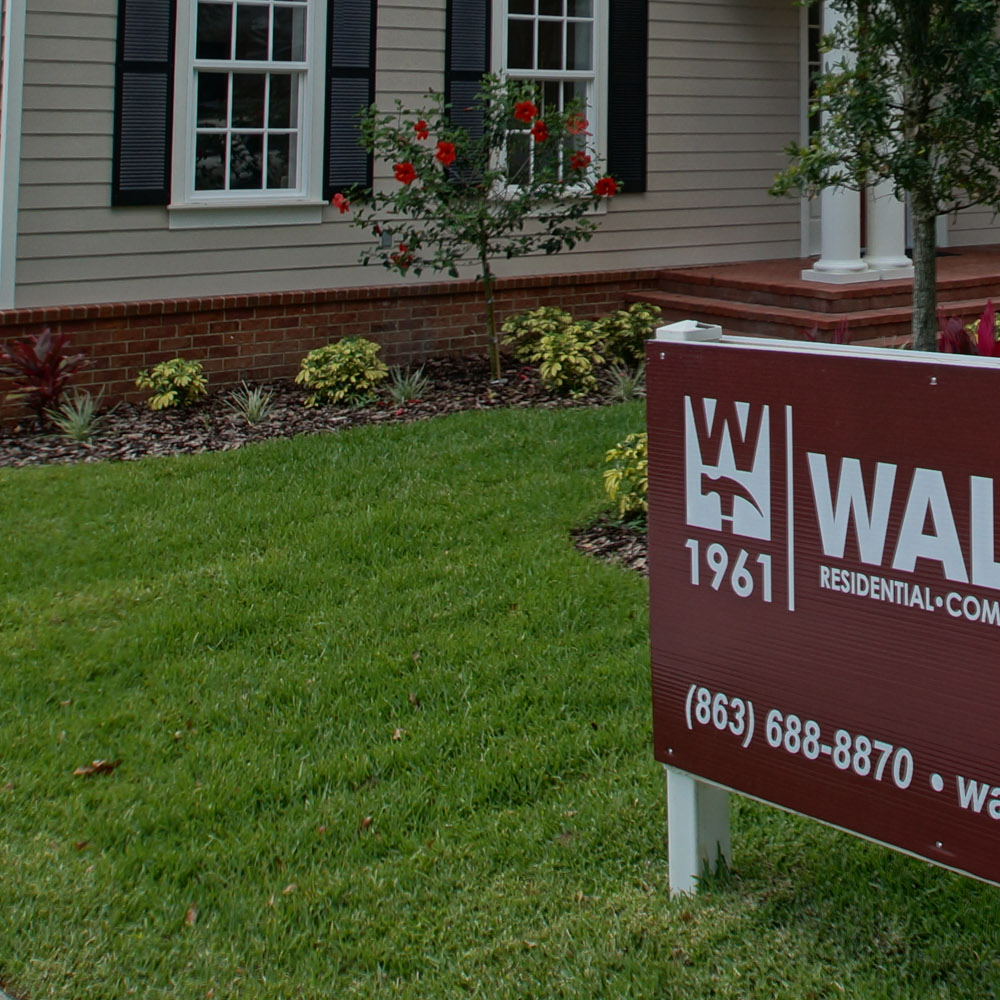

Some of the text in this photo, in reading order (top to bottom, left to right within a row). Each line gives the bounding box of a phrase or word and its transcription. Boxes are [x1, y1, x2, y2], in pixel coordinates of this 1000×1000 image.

[684, 538, 772, 603] 1961
[684, 684, 755, 748] (863)
[765, 709, 914, 789] 688-8870
